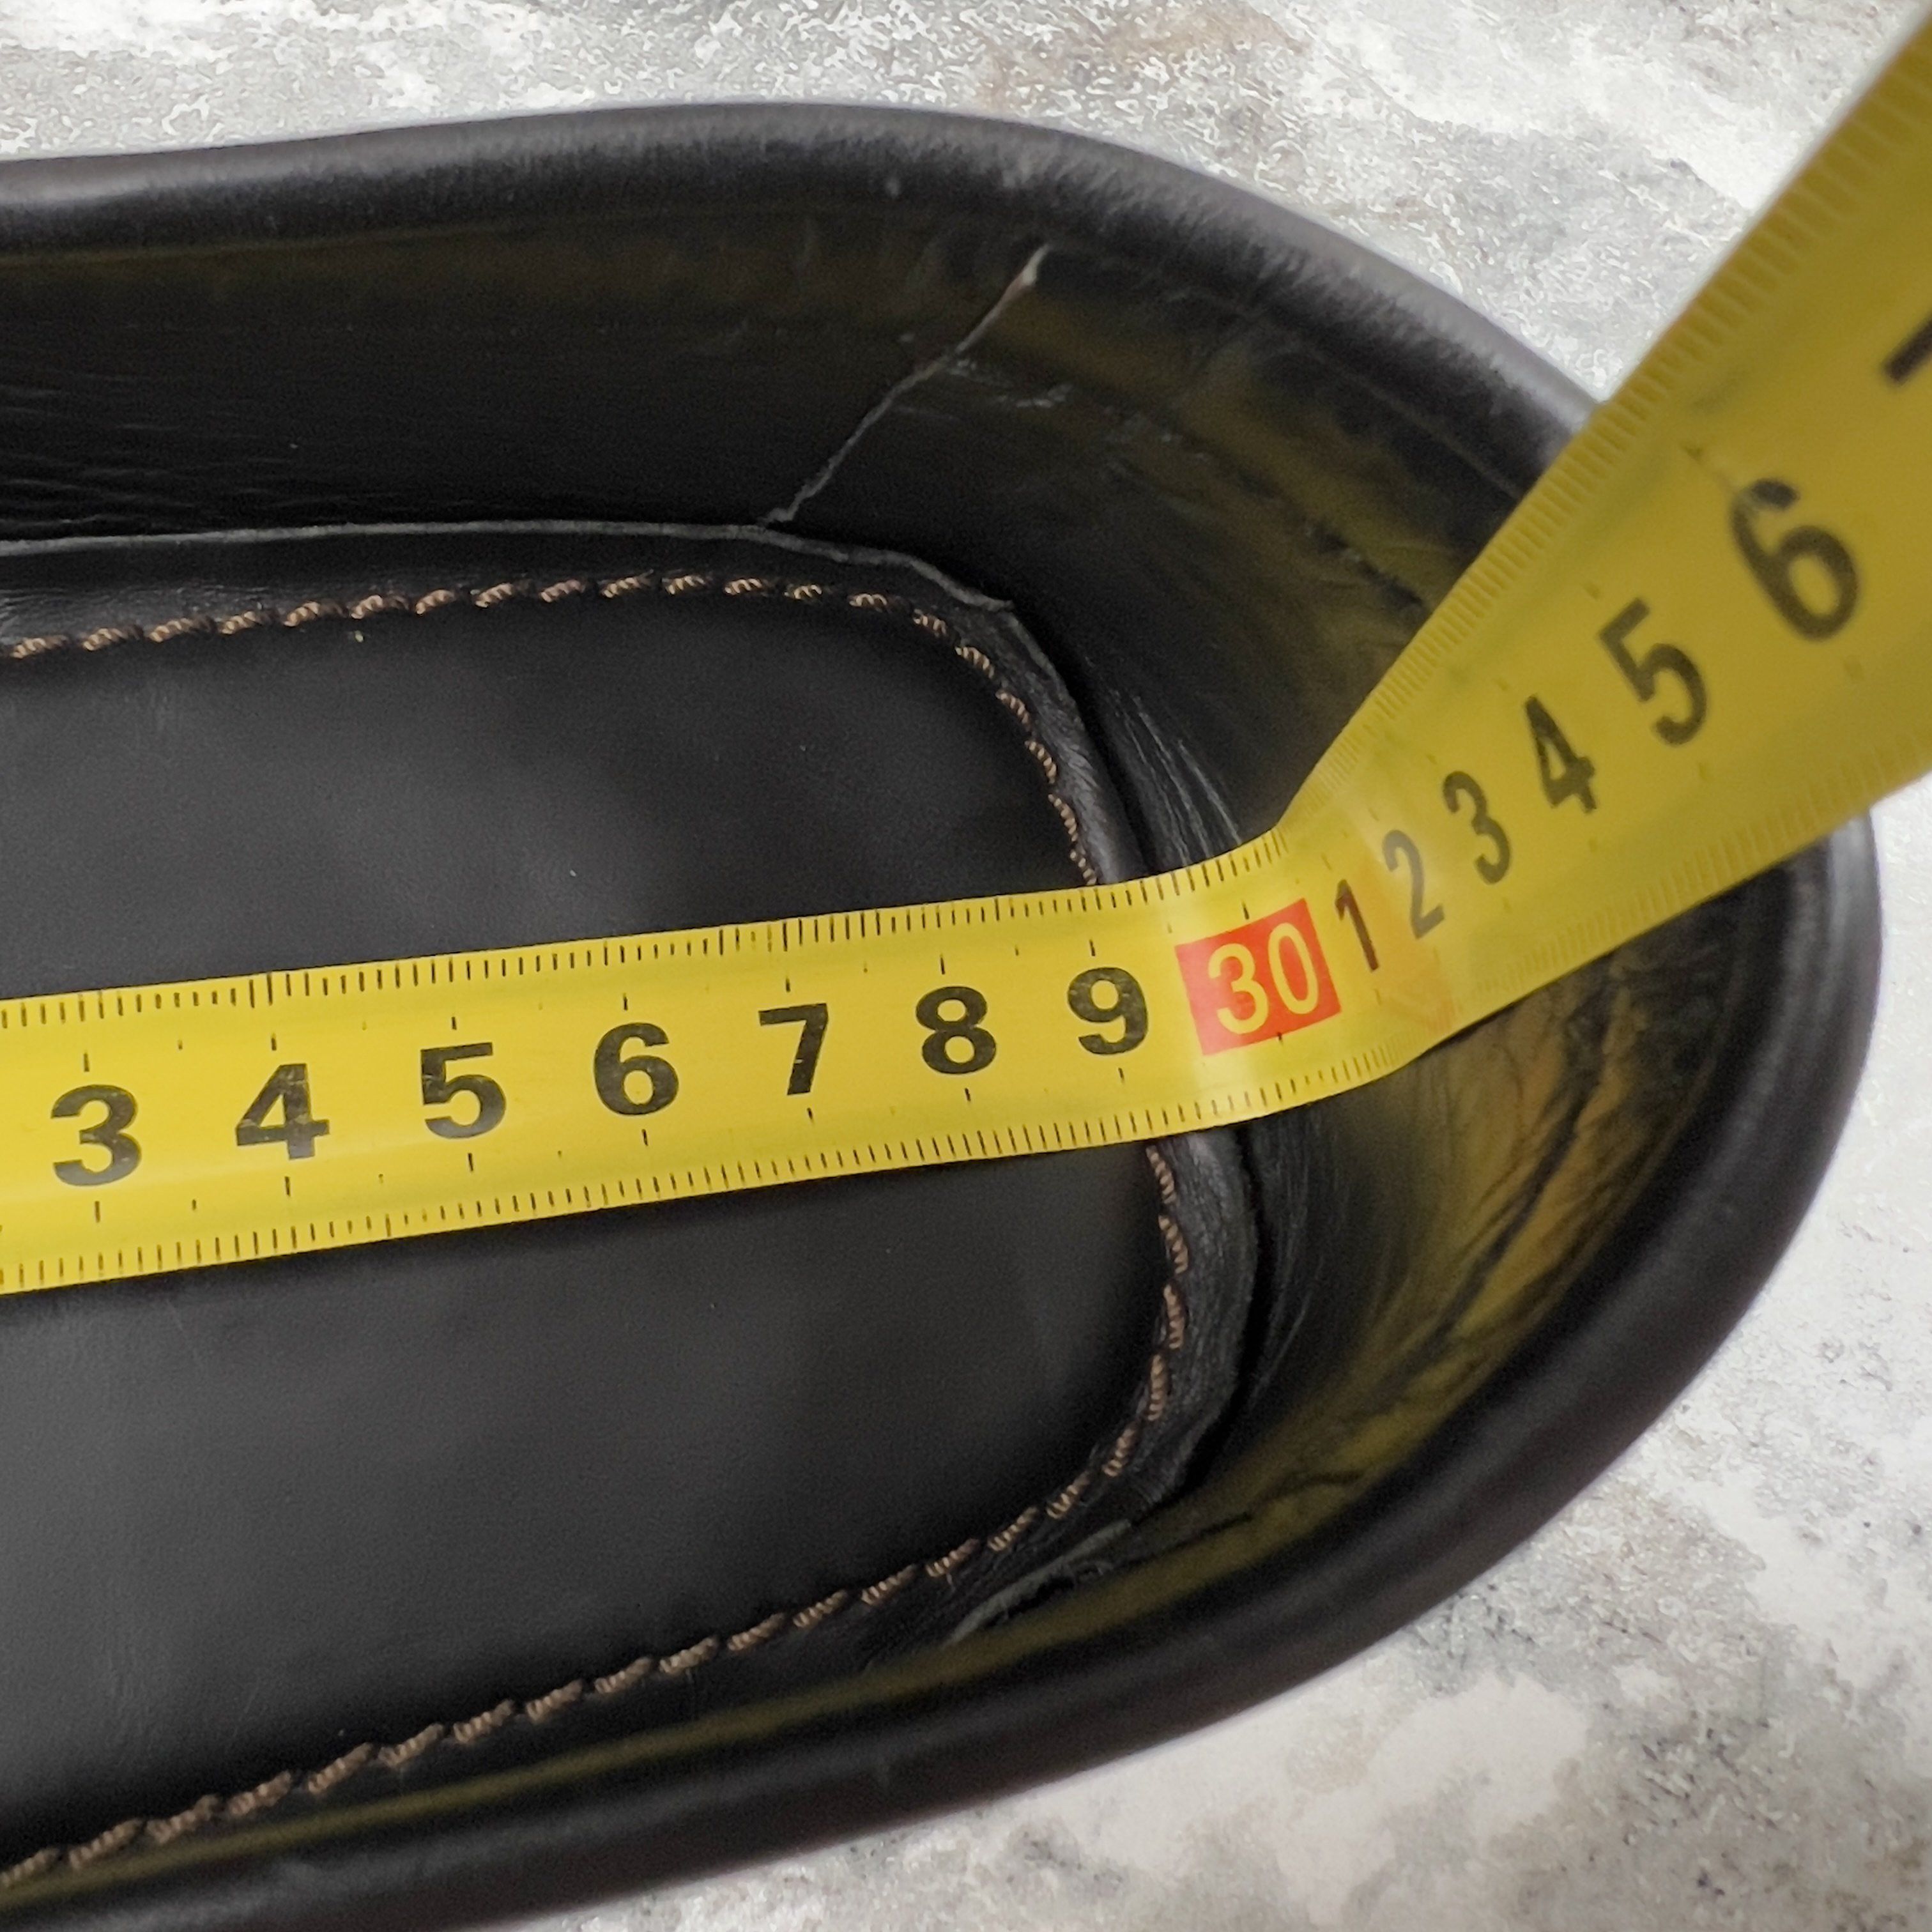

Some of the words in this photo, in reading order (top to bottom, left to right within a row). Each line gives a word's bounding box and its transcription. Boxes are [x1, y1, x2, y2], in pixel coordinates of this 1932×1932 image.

[50, 1084, 142, 1186] 3
[235, 1063, 329, 1160] 4
[419, 1042, 505, 1138] 5
[594, 1022, 678, 1116] 6
[758, 1003, 829, 1096] 7
[915, 986, 997, 1075] 8
[1067, 967, 1149, 1056] 9
[1208, 923, 1319, 1034] 30
[1335, 879, 1380, 972] 1
[1382, 829, 1445, 939] 2
[1442, 770, 1512, 884] 3
[1524, 694, 1596, 813] 4
[1598, 597, 1708, 747] 5
[1730, 477, 1862, 642] 6
